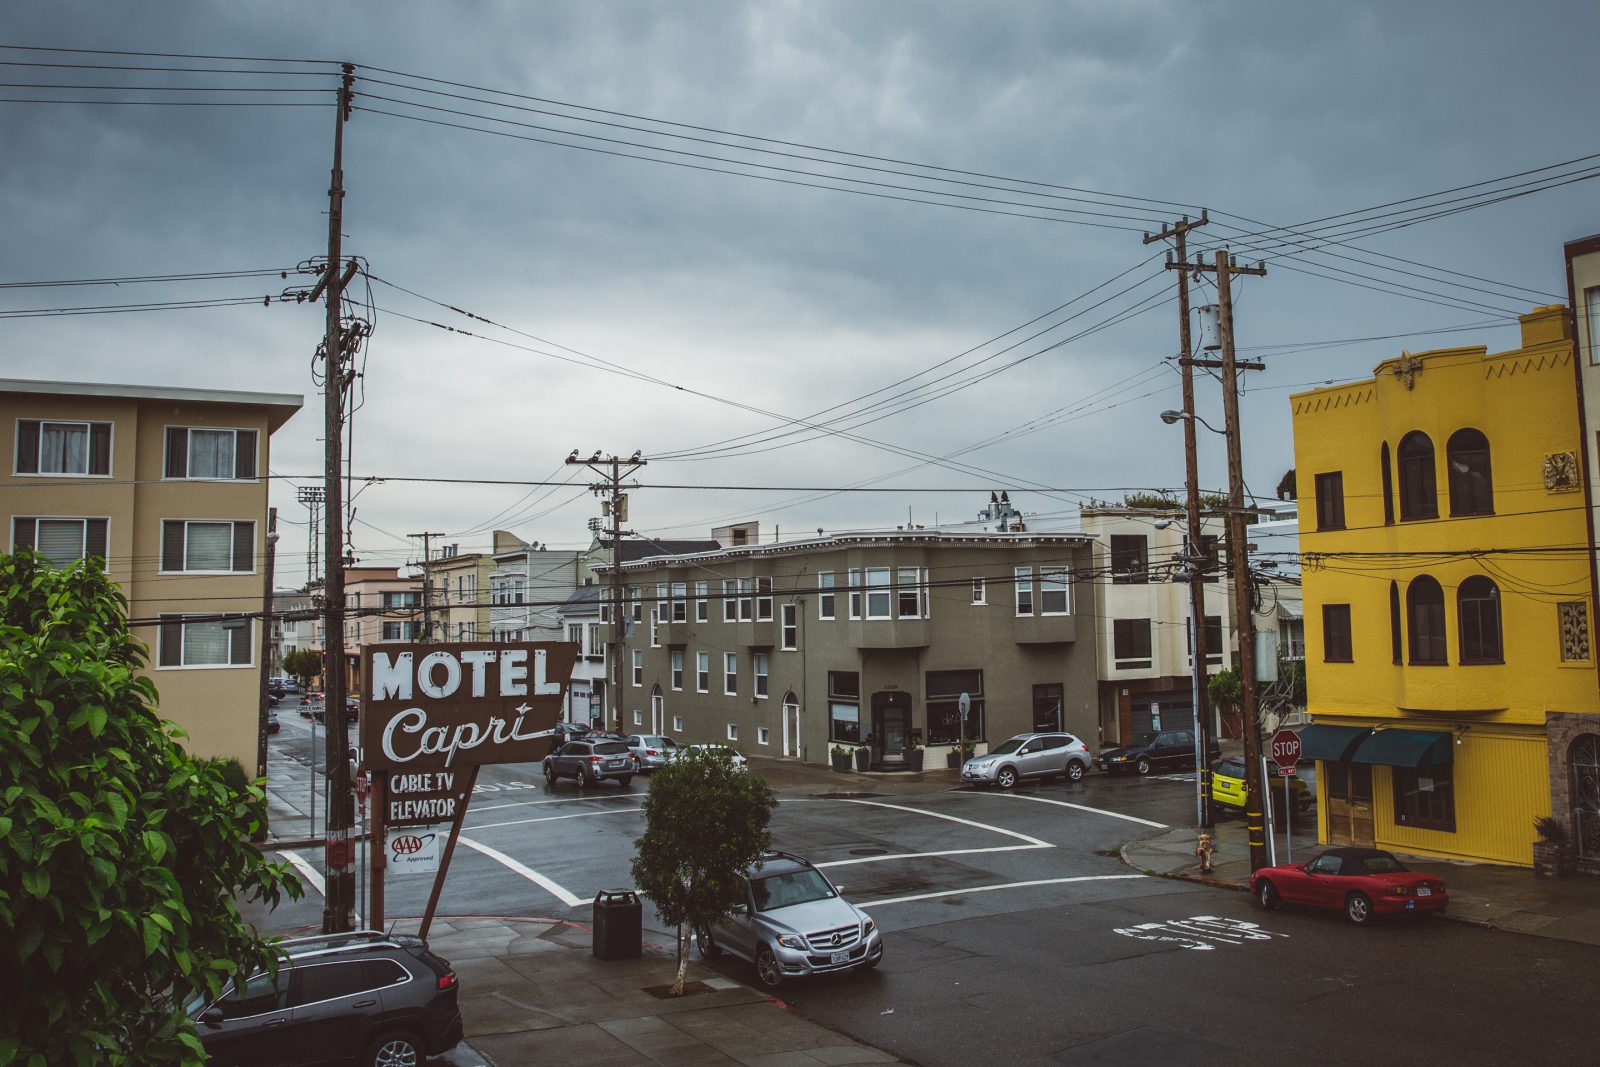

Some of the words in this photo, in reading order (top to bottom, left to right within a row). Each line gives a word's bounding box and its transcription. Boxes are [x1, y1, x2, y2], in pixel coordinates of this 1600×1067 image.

[372, 649, 561, 701] MOTEL
[382, 702, 555, 768] Capri
[1273, 741, 1299, 757] STOP
[390, 773, 432, 794] CABLE
[435, 772, 455, 791] TV
[390, 797, 456, 821] ELEVATOR
[393, 835, 421, 854] AAA
[406, 855, 434, 863] Approved
